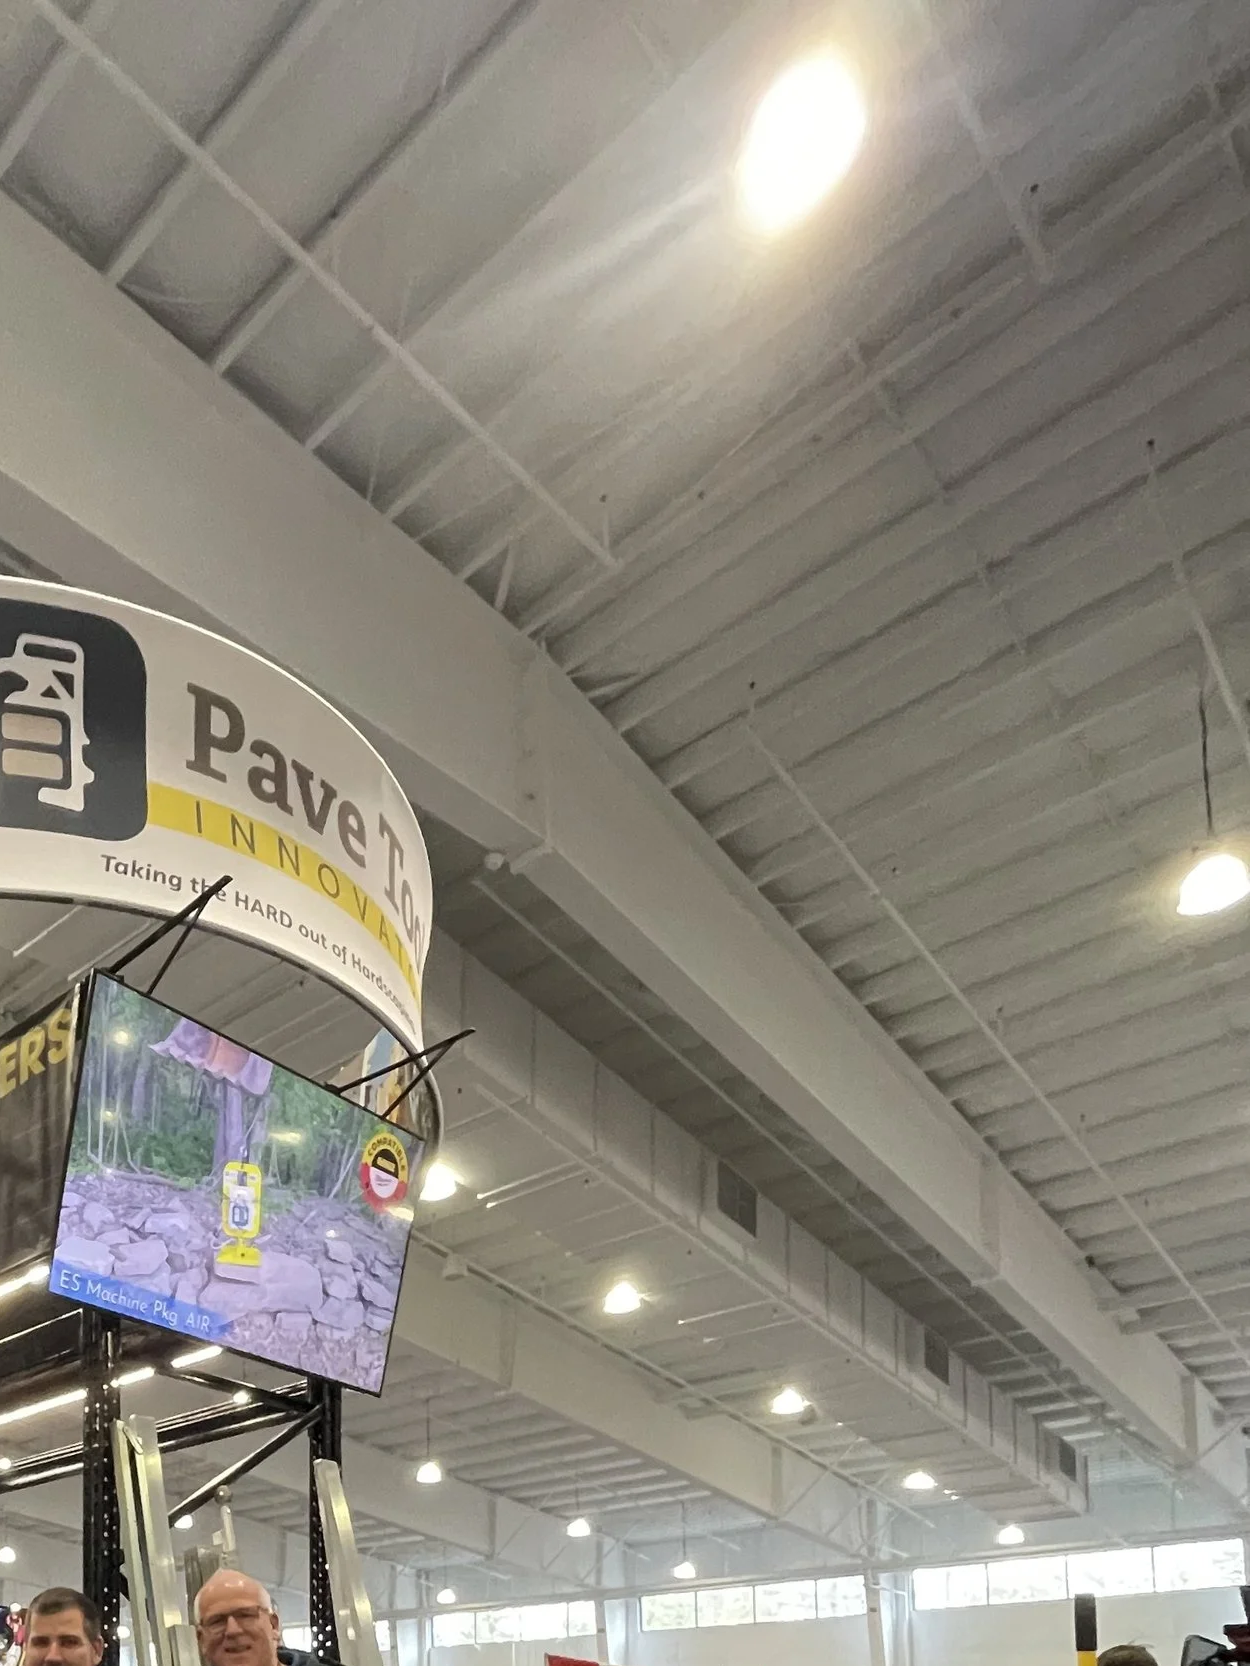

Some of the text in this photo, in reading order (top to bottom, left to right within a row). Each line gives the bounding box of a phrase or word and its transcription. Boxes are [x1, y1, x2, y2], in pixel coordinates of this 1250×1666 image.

[186, 682, 367, 868] Pave
[101, 854, 182, 892] Taking
[235, 890, 293, 929] HARD
[298, 923, 328, 949] out
[332, 945, 348, 965] of
[60, 1269, 210, 1333] ES Machine Pkg AIR
